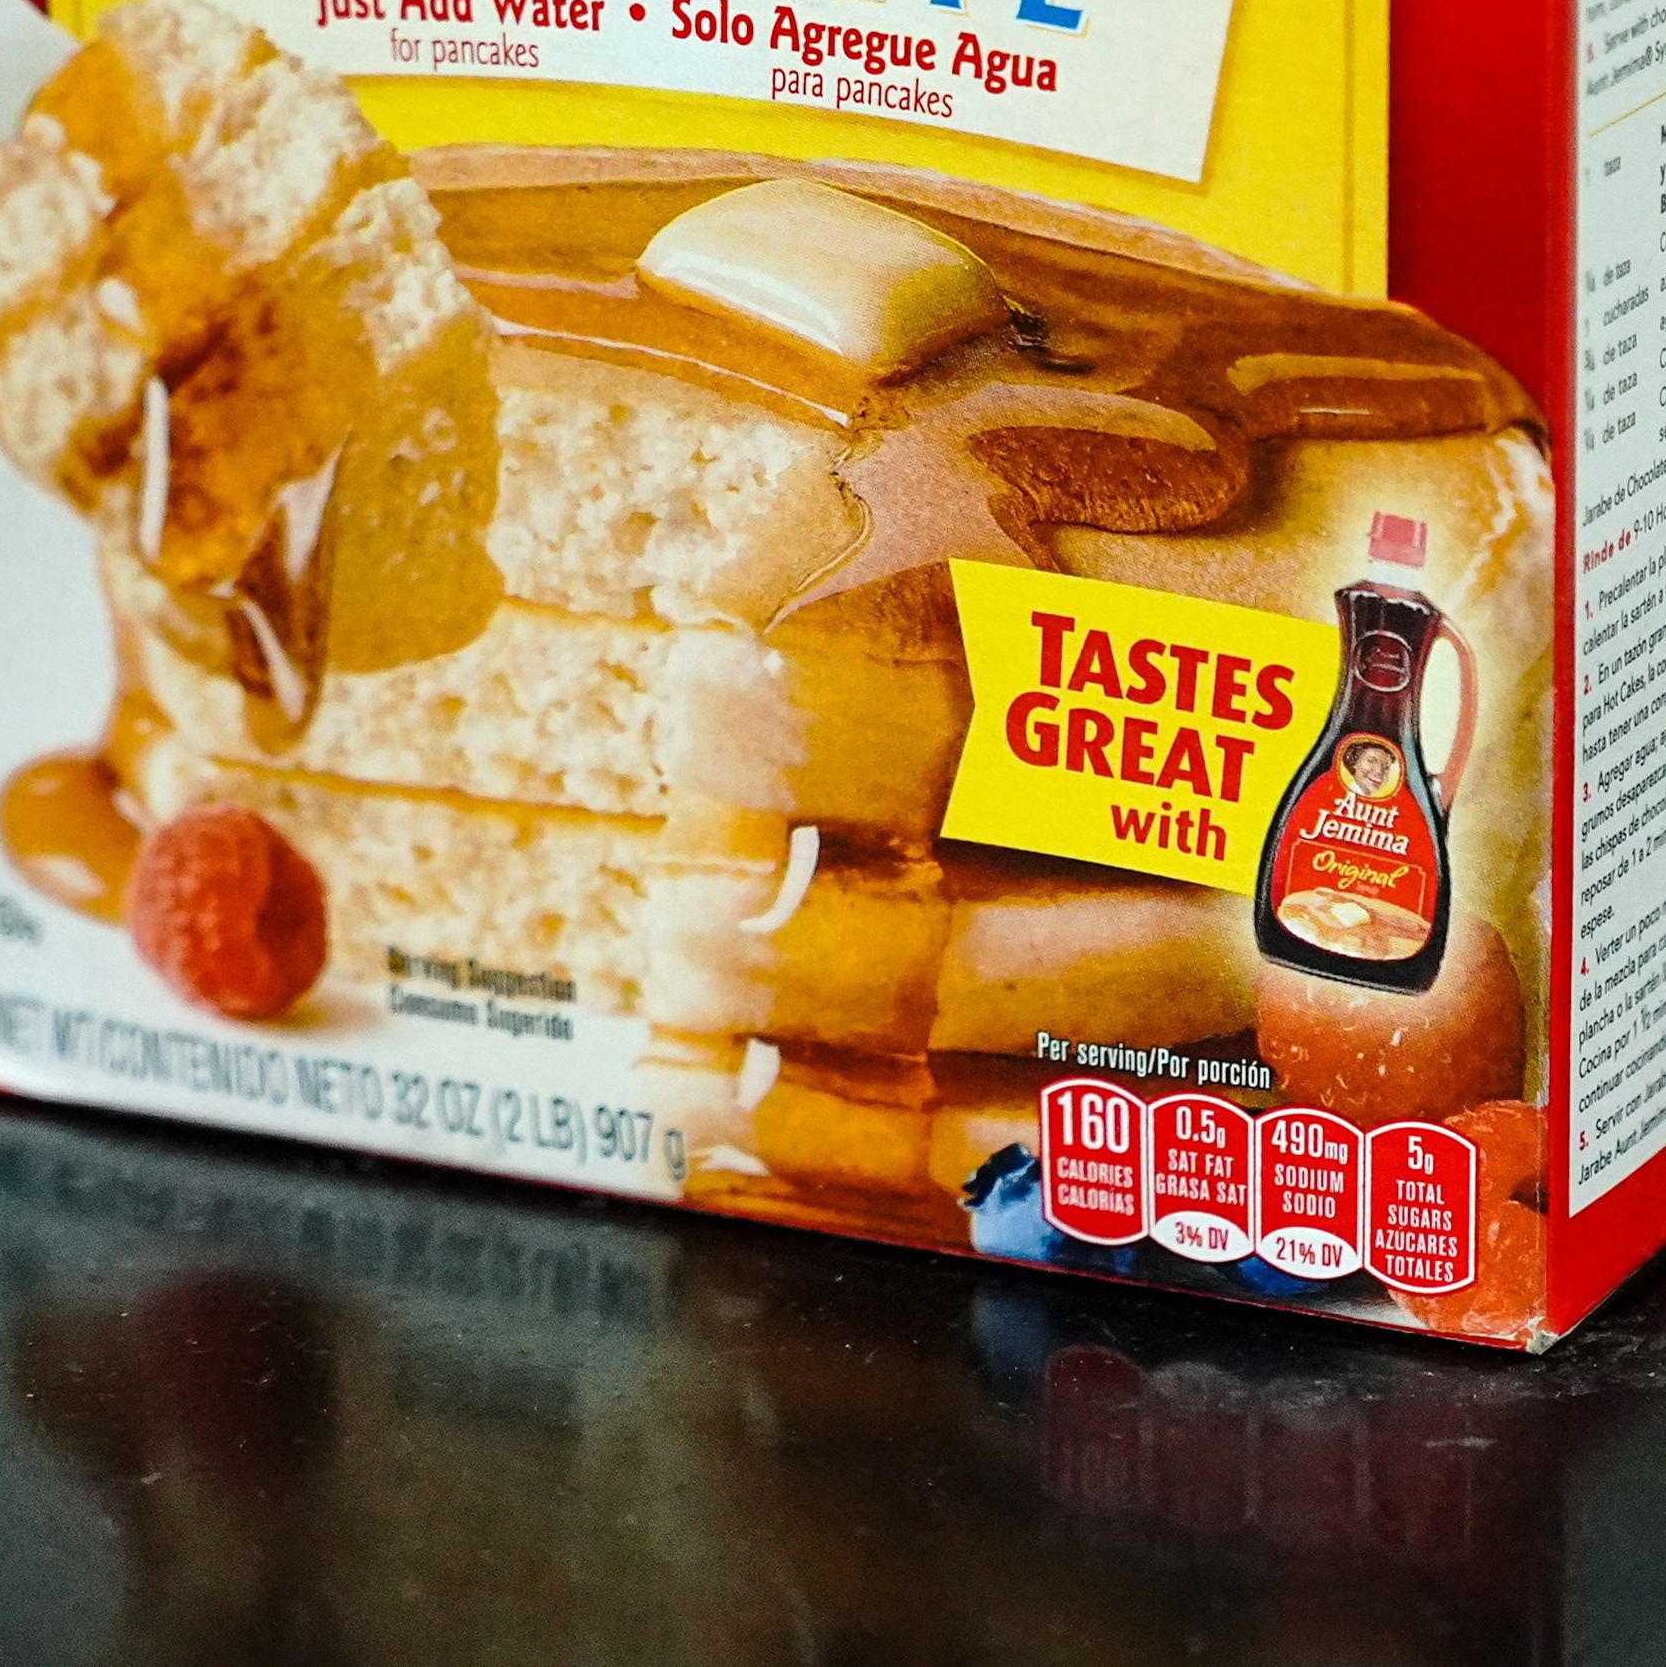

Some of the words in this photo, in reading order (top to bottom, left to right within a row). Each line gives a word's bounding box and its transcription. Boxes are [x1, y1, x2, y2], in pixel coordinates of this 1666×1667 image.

[390, 28, 421, 62] for
[432, 33, 539, 70] pancakes
[770, 6, 936, 75] Agregue
[951, 32, 1057, 94] Agua
[771, 68, 823, 100] para
[836, 75, 954, 118] pancakes
[1603, 286, 1649, 327] cucharadas
[1618, 334, 1637, 355] taza
[1617, 412, 1636, 433] taza
[1582, 492, 1612, 527] Jarabe
[1614, 482, 1625, 505] de
[1583, 540, 1614, 574] Rinde
[1618, 529, 1631, 551] de
[1633, 509, 1654, 539] 9-10
[1599, 563, 1647, 610] Precalentar
[1583, 618, 1619, 656] calentar
[1630, 592, 1657, 624] sartén
[1032, 610, 1295, 730] TASTES
[1624, 637, 1647, 666] tazón
[1603, 690, 1619, 715] Hot
[1006, 691, 1255, 803] GREAT
[1582, 738, 1606, 765] hasta
[1609, 715, 1632, 746] tener
[1633, 705, 1649, 725] una
[1597, 751, 1632, 793] Agregar
[1334, 791, 1399, 828] Aunt
[1582, 801, 1614, 842] grumos
[1111, 802, 1227, 861] with
[1299, 809, 1409, 855] Jemima
[1595, 827, 1627, 863] chispas
[1312, 851, 1409, 889] Original
[1580, 869, 1616, 906] reposar
[1580, 904, 1615, 940] espese.
[1595, 932, 1623, 966] Verter
[1639, 906, 1661, 939] poco
[1605, 957, 1636, 994] mezcla
[1578, 1008, 1614, 1053] plancha
[1037, 1031, 1070, 1062] Per
[1076, 1042, 1190, 1078] serving/Por
[1197, 1058, 1271, 1089] porción
[1579, 1047, 1612, 1079] Cocina
[1579, 1066, 1624, 1114] continuar
[294, 1055, 384, 1122] NETO
[391, 1069, 430, 1129] 32
[438, 1078, 482, 1135] OZ
[489, 1086, 522, 1155] (2
[530, 1092, 588, 1167] LB)
[594, 1104, 653, 1164] 907
[663, 1127, 686, 1183] g
[1057, 1091, 1130, 1154] 160
[1175, 1106, 1226, 1149] 0.5g
[1595, 1104, 1624, 1140] Servir
[1271, 1120, 1348, 1165] 490mg
[1407, 1135, 1434, 1175] 5g
[1578, 1149, 1612, 1185] Jarabe
[1614, 1129, 1637, 1159] Aunt
[1057, 1156, 1133, 1188] CALORIES
[1168, 1148, 1198, 1174] SAT
[1205, 1154, 1234, 1179] FAT
[1274, 1163, 1344, 1193] SODIUM
[1057, 1184, 1134, 1216] CALORÍAS
[1155, 1173, 1210, 1201] GRASA
[1216, 1183, 1247, 1206] SAT
[1282, 1191, 1336, 1219] SODIO
[1396, 1179, 1445, 1205] TOTAL
[1175, 1221, 1203, 1247] 3%
[1208, 1225, 1229, 1251] DV
[1388, 1204, 1452, 1231] SUGARS
[1276, 1237, 1316, 1265] 21%
[1322, 1243, 1343, 1268] DV
[1375, 1226, 1458, 1258] AZÚCARES
[1385, 1254, 1454, 1283] TOTALES
